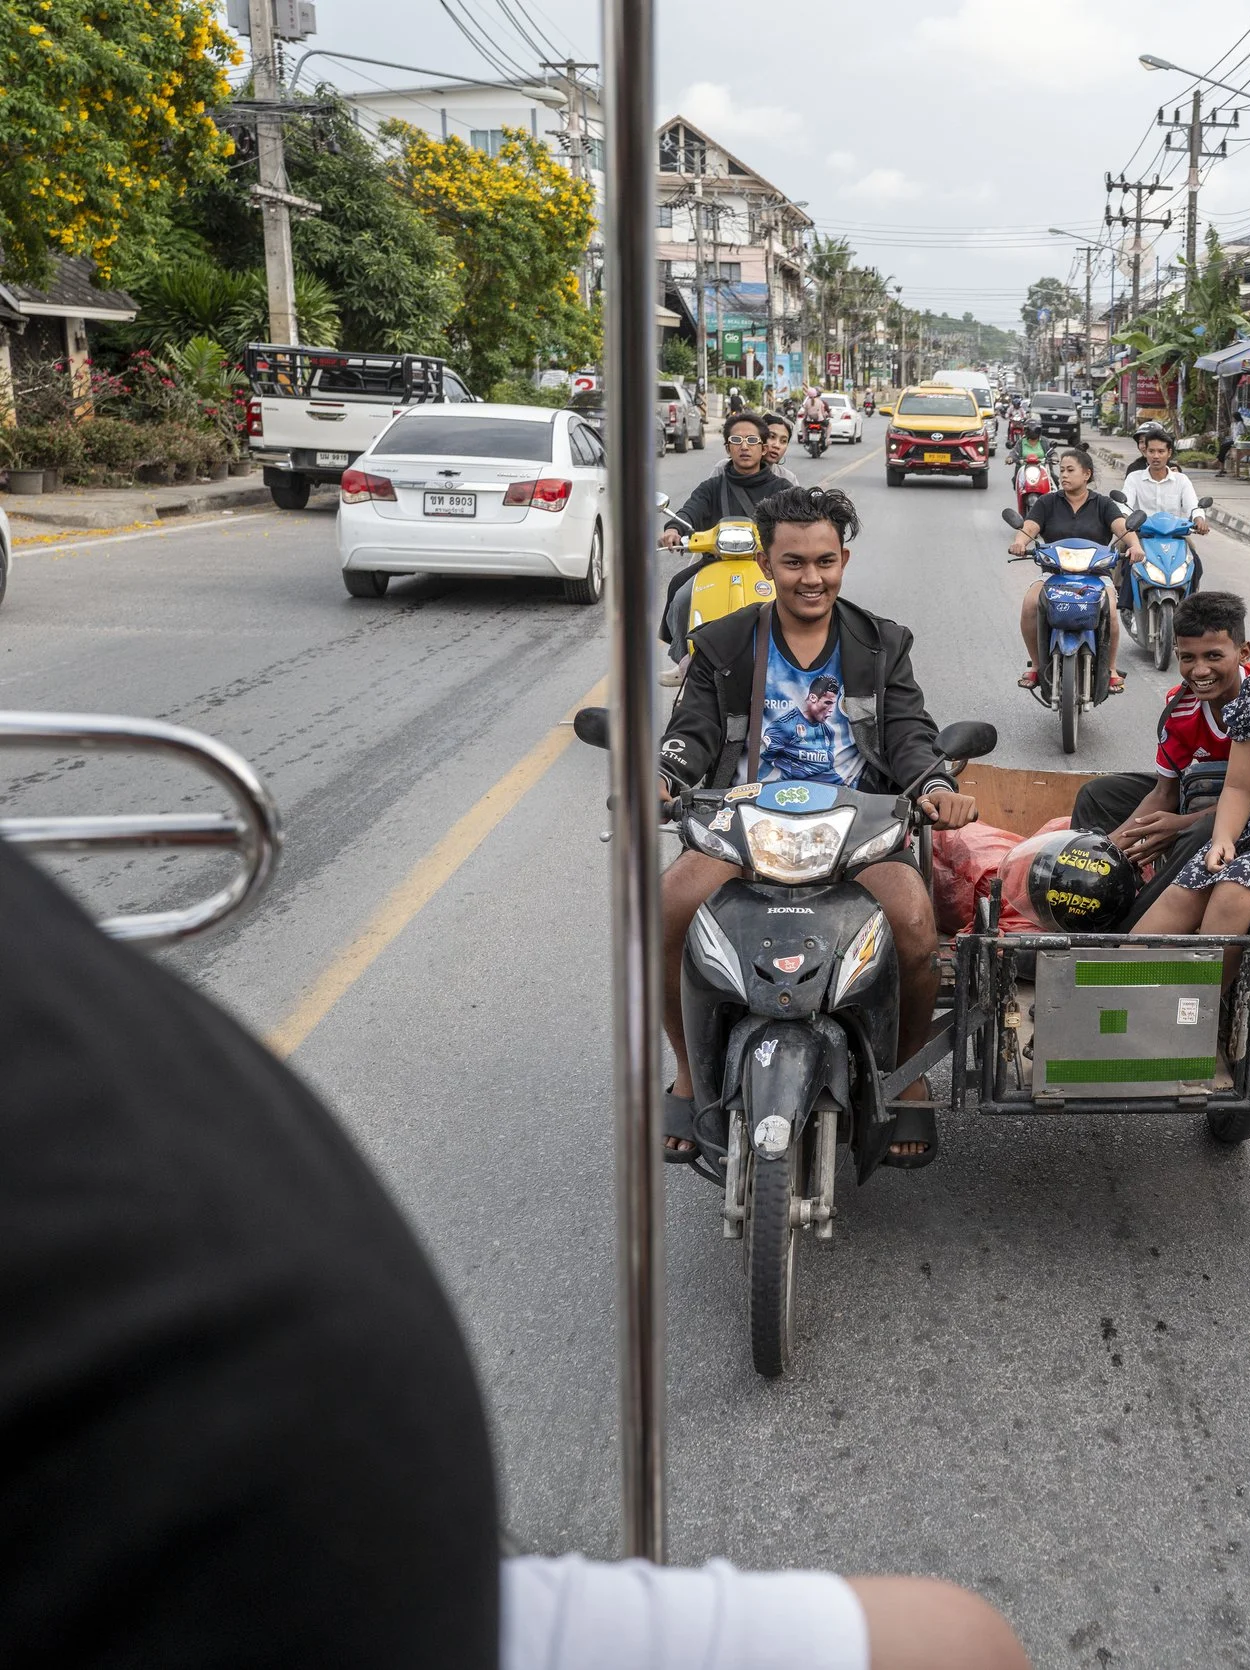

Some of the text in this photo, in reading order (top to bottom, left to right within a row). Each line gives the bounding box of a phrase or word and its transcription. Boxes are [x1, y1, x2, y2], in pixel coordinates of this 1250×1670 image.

[449, 496, 473, 507] 8903
[1071, 848, 1090, 858] MAN
[1057, 851, 1111, 876] SPIDER
[1046, 889, 1101, 912] SPIDER
[766, 906, 815, 914] HONDA
[1068, 906, 1087, 916] MAN
